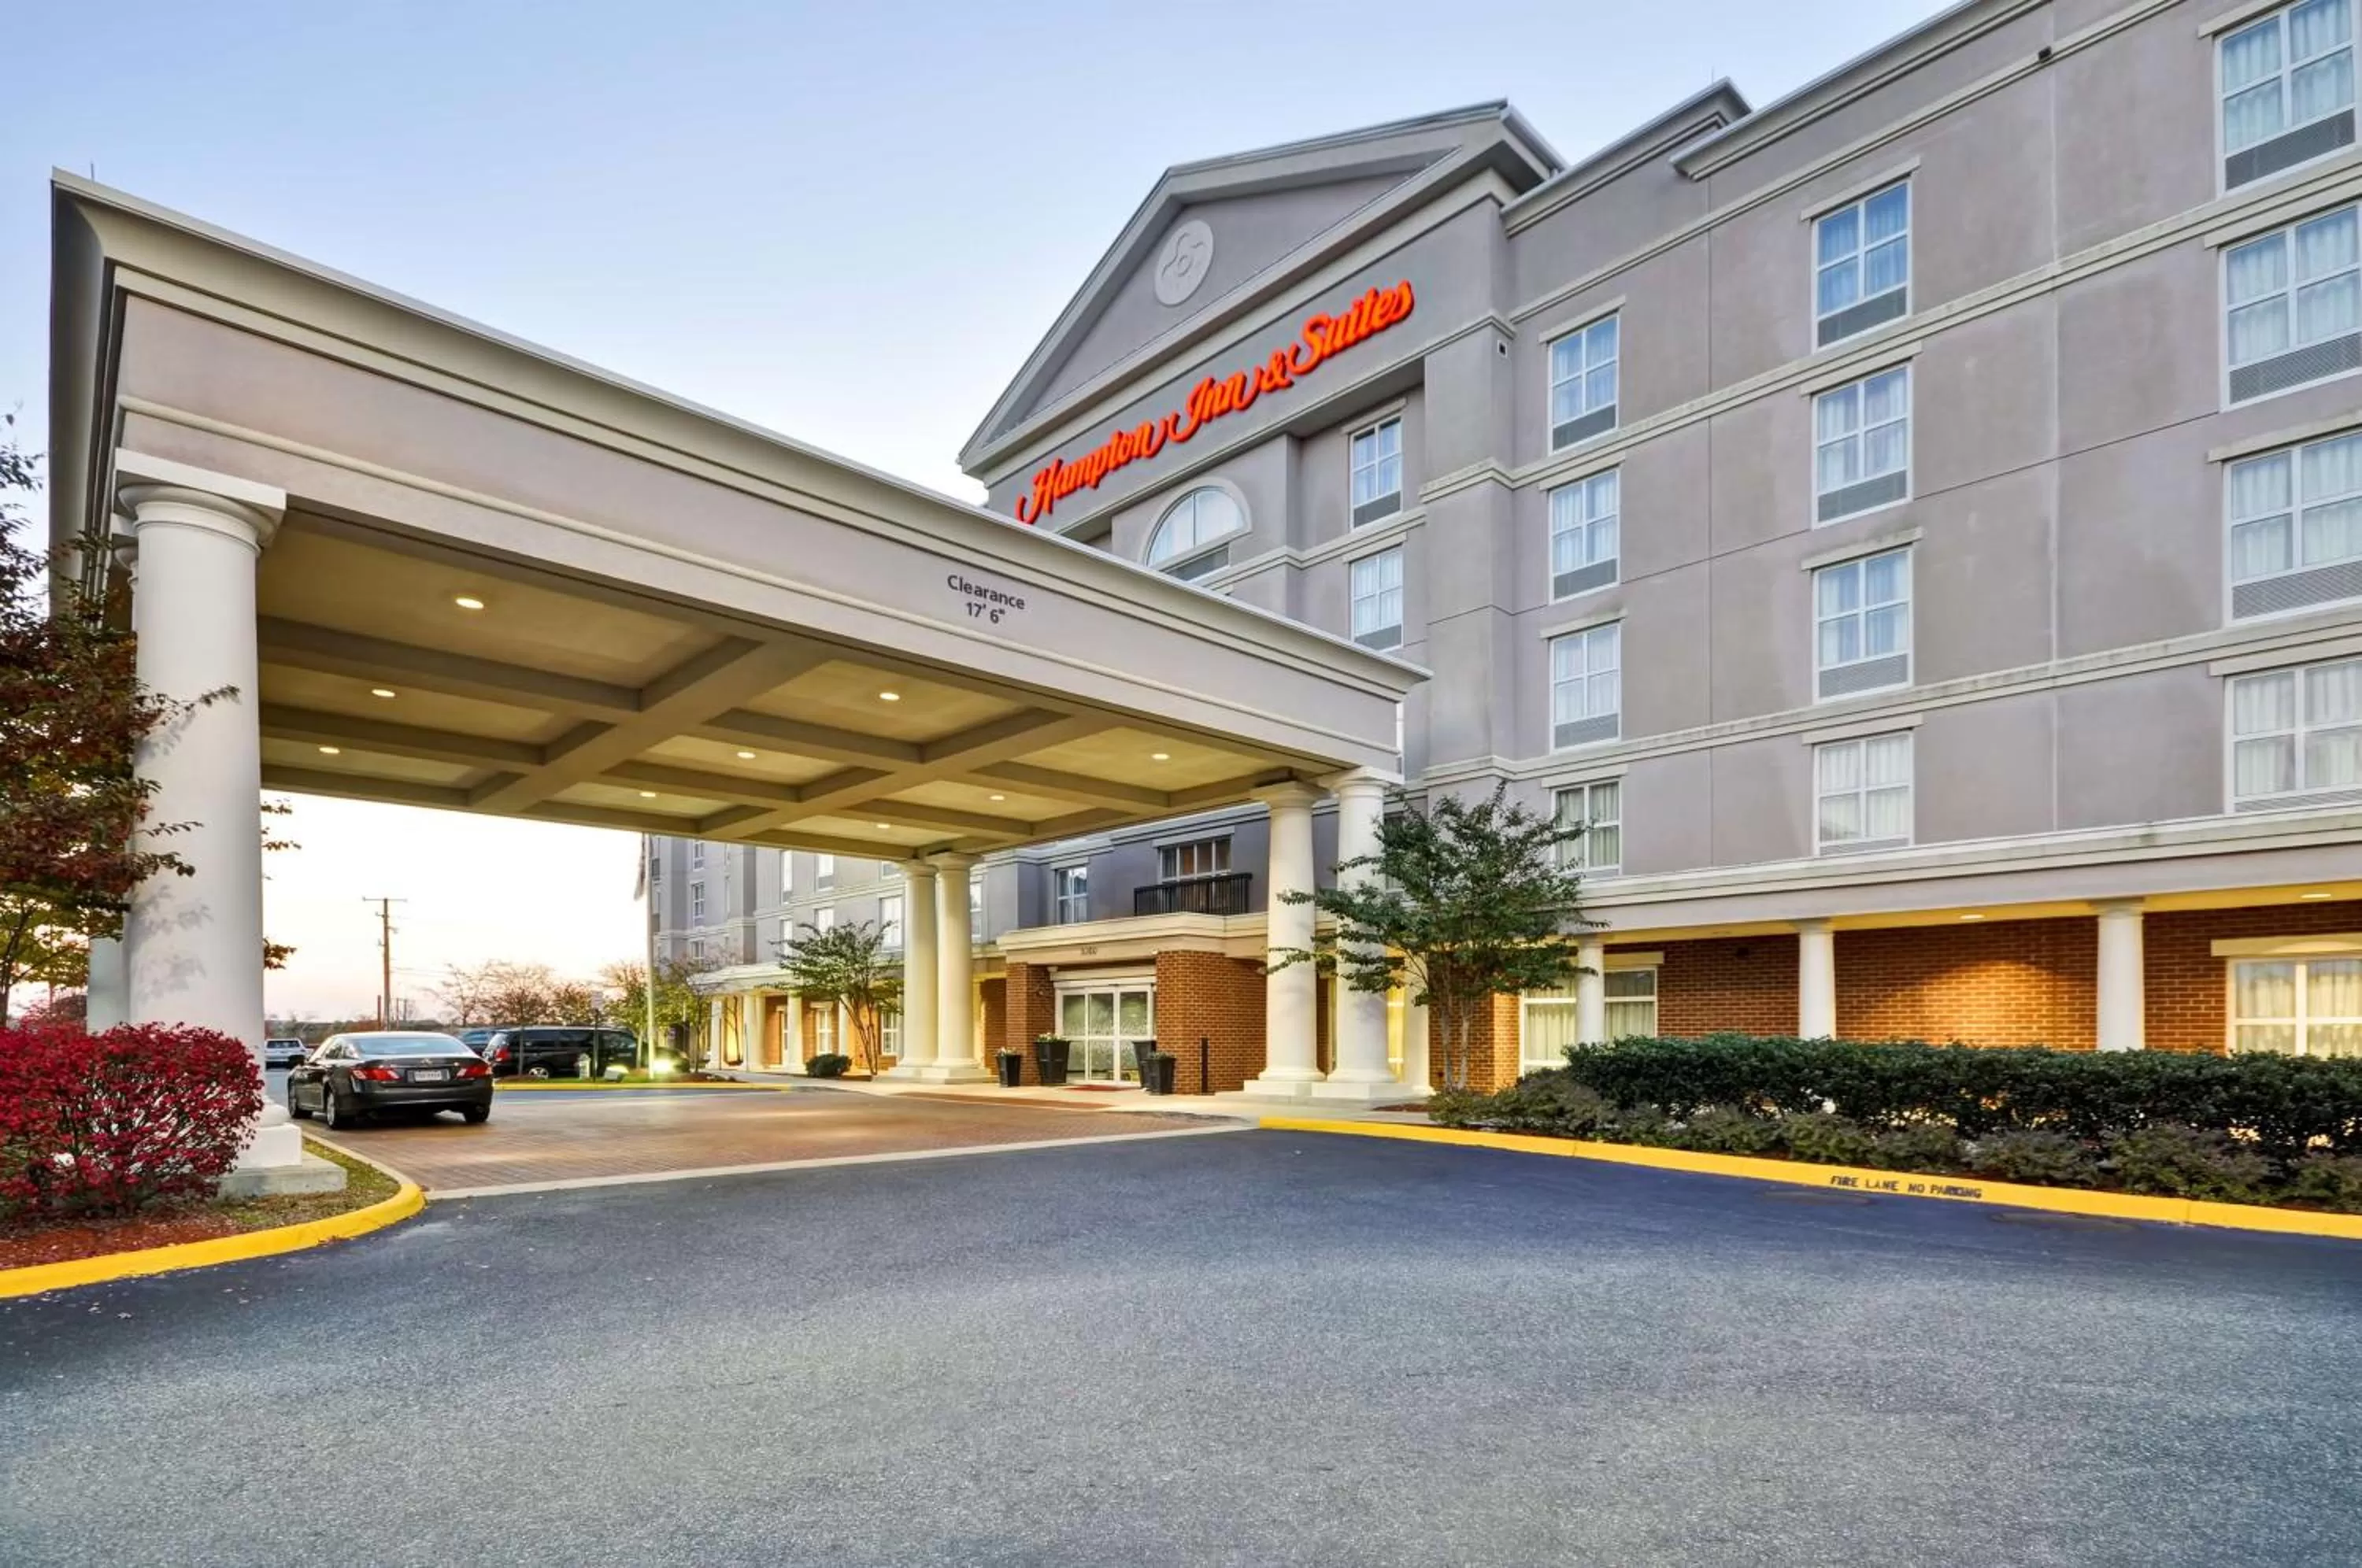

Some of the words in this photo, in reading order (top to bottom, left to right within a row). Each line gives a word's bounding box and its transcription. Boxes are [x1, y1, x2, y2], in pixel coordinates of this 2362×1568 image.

[1015, 418, 1168, 524] Hampton
[1168, 364, 1264, 443] Inn
[1260, 349, 1294, 392] &
[1287, 279, 1415, 375] Suites
[947, 574, 1025, 610] Clearance
[1830, 1175, 1859, 1188] FIRE
[1865, 1178, 1900, 1191] LANE
[1908, 1183, 1926, 1193] NO
